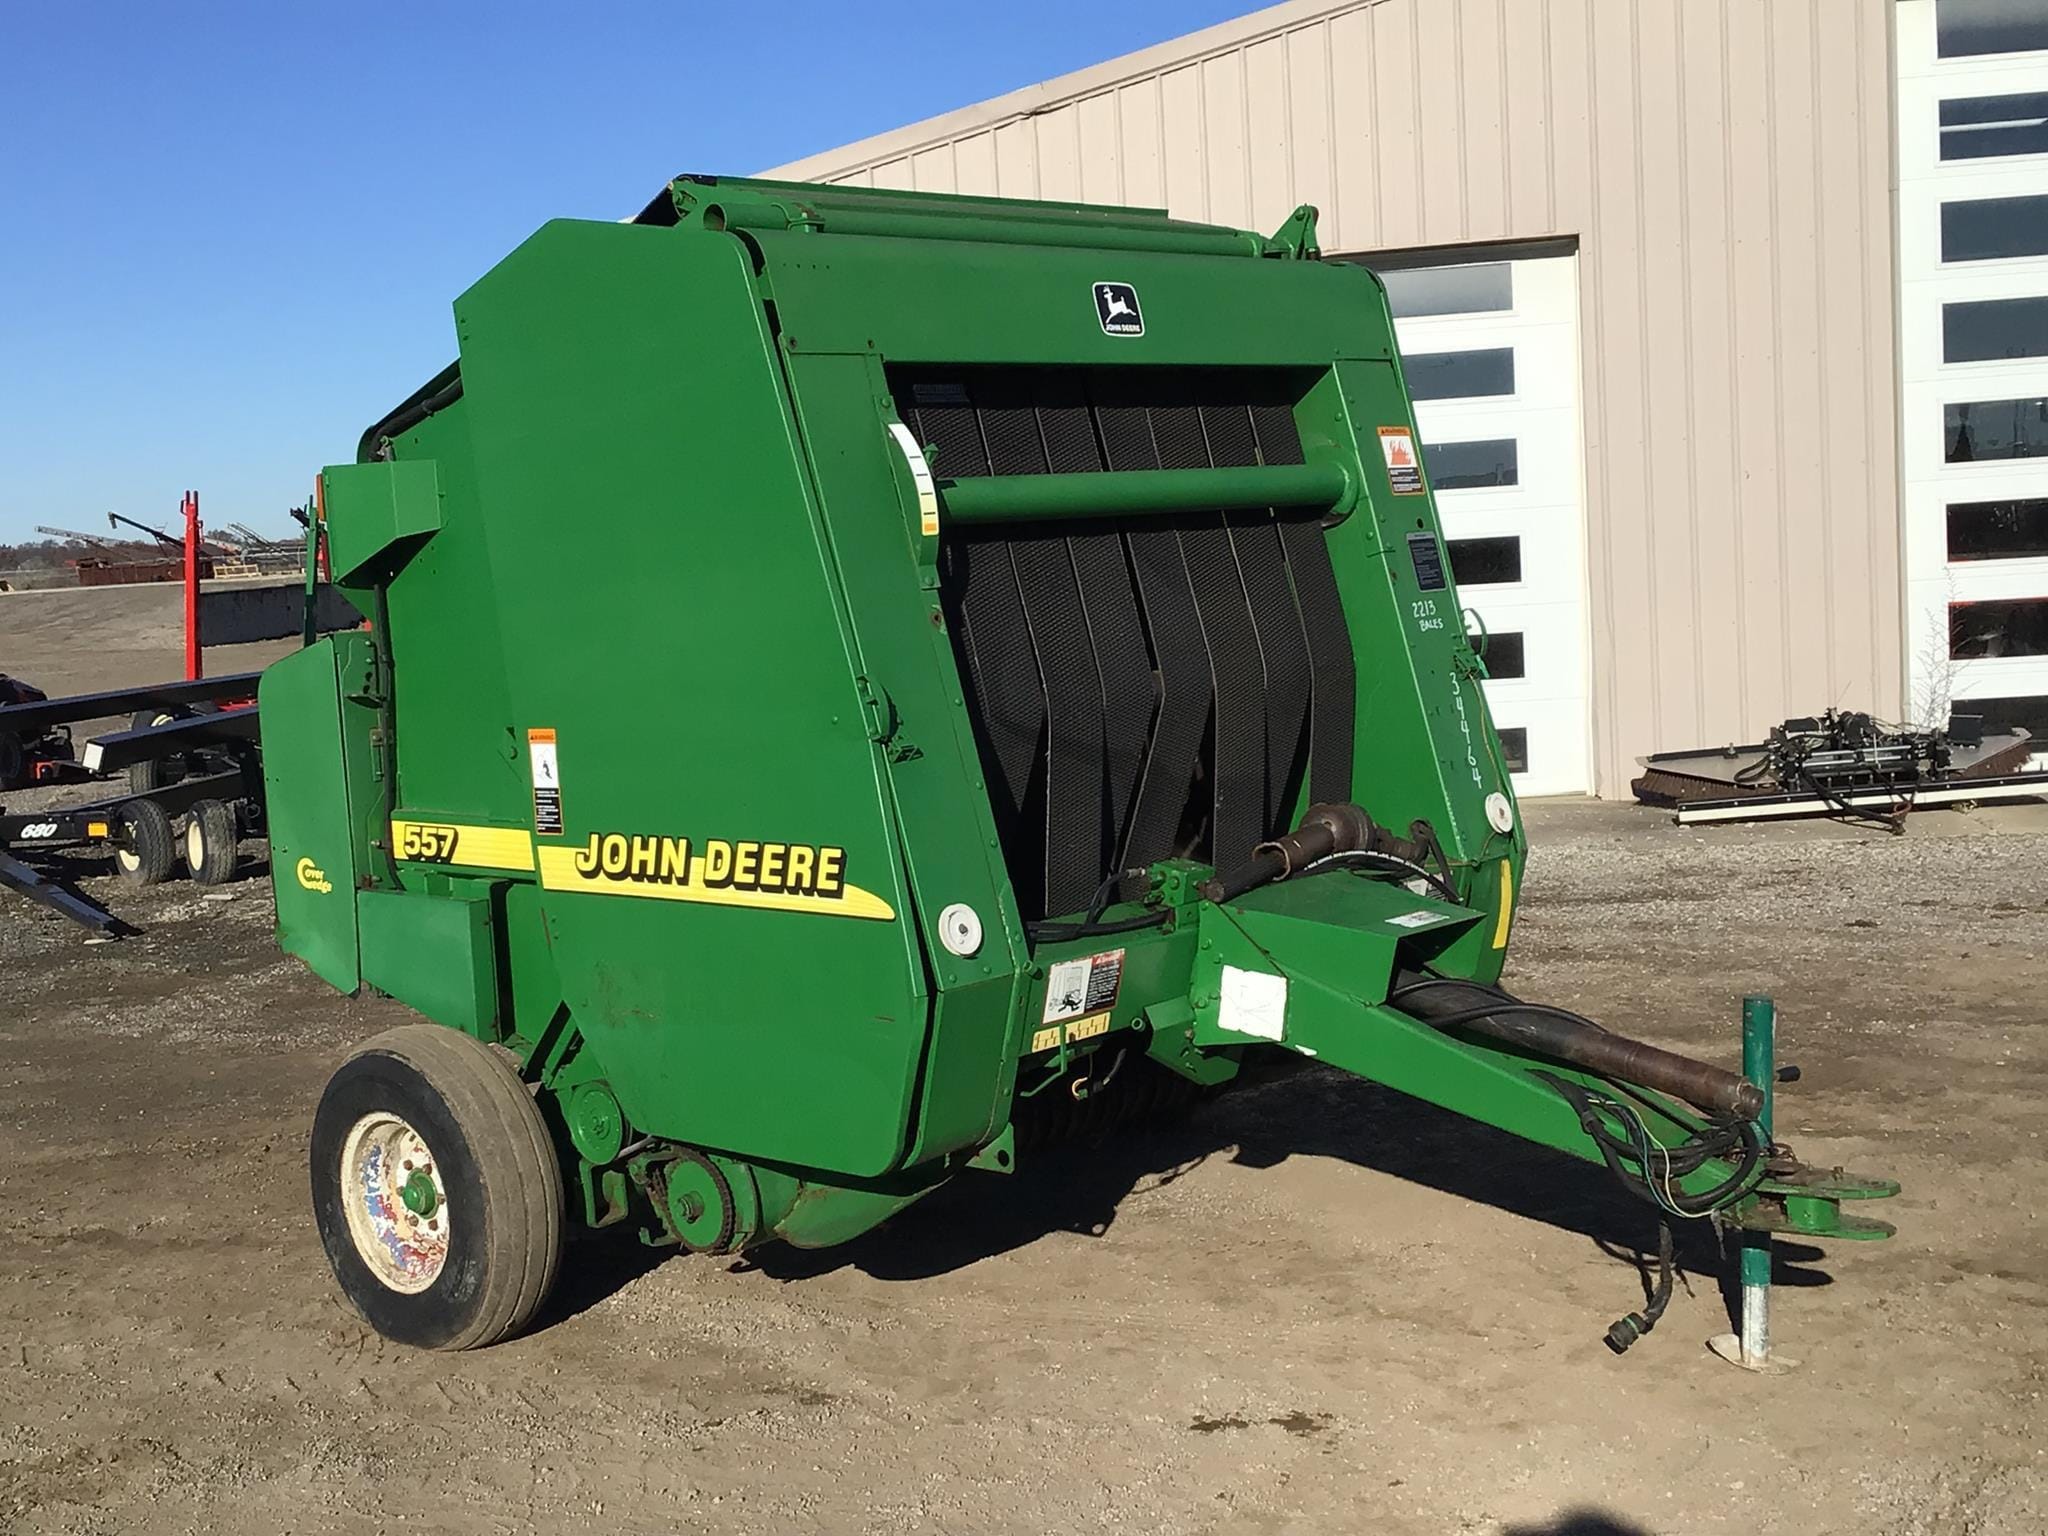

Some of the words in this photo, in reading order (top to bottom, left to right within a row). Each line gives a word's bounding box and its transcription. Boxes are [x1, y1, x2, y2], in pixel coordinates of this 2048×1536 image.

[1412, 600, 1436, 618] 2213
[1419, 618, 1444, 632] BALES
[1449, 671, 1482, 789] 34464
[21, 824, 58, 838] 680
[403, 824, 459, 864] 557
[575, 832, 692, 886] JOHN
[703, 839, 847, 899] DEERE
